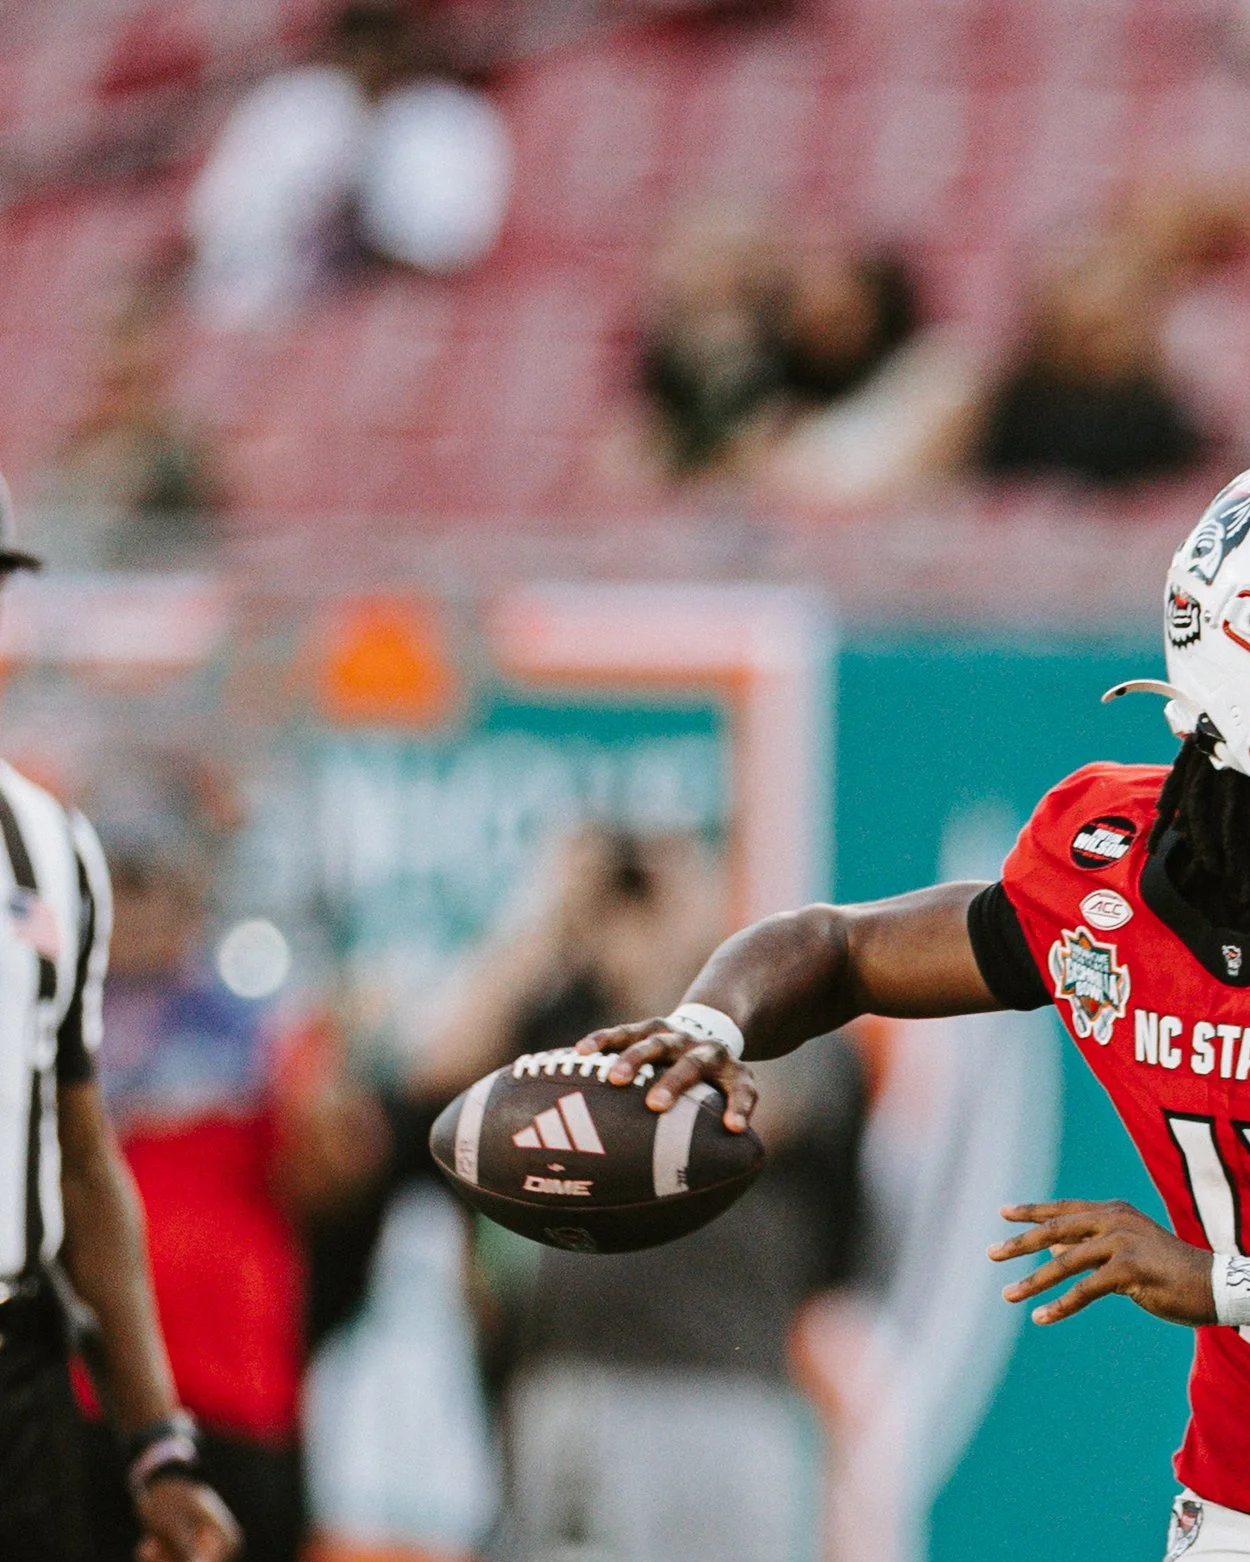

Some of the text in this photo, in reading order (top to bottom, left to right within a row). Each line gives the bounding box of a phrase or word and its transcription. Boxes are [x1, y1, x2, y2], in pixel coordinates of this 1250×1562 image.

[1073, 831, 1130, 859] WILSON
[1088, 900, 1124, 916] ACC
[1134, 1008, 1183, 1070] NC
[522, 1175, 594, 1197] DIME
